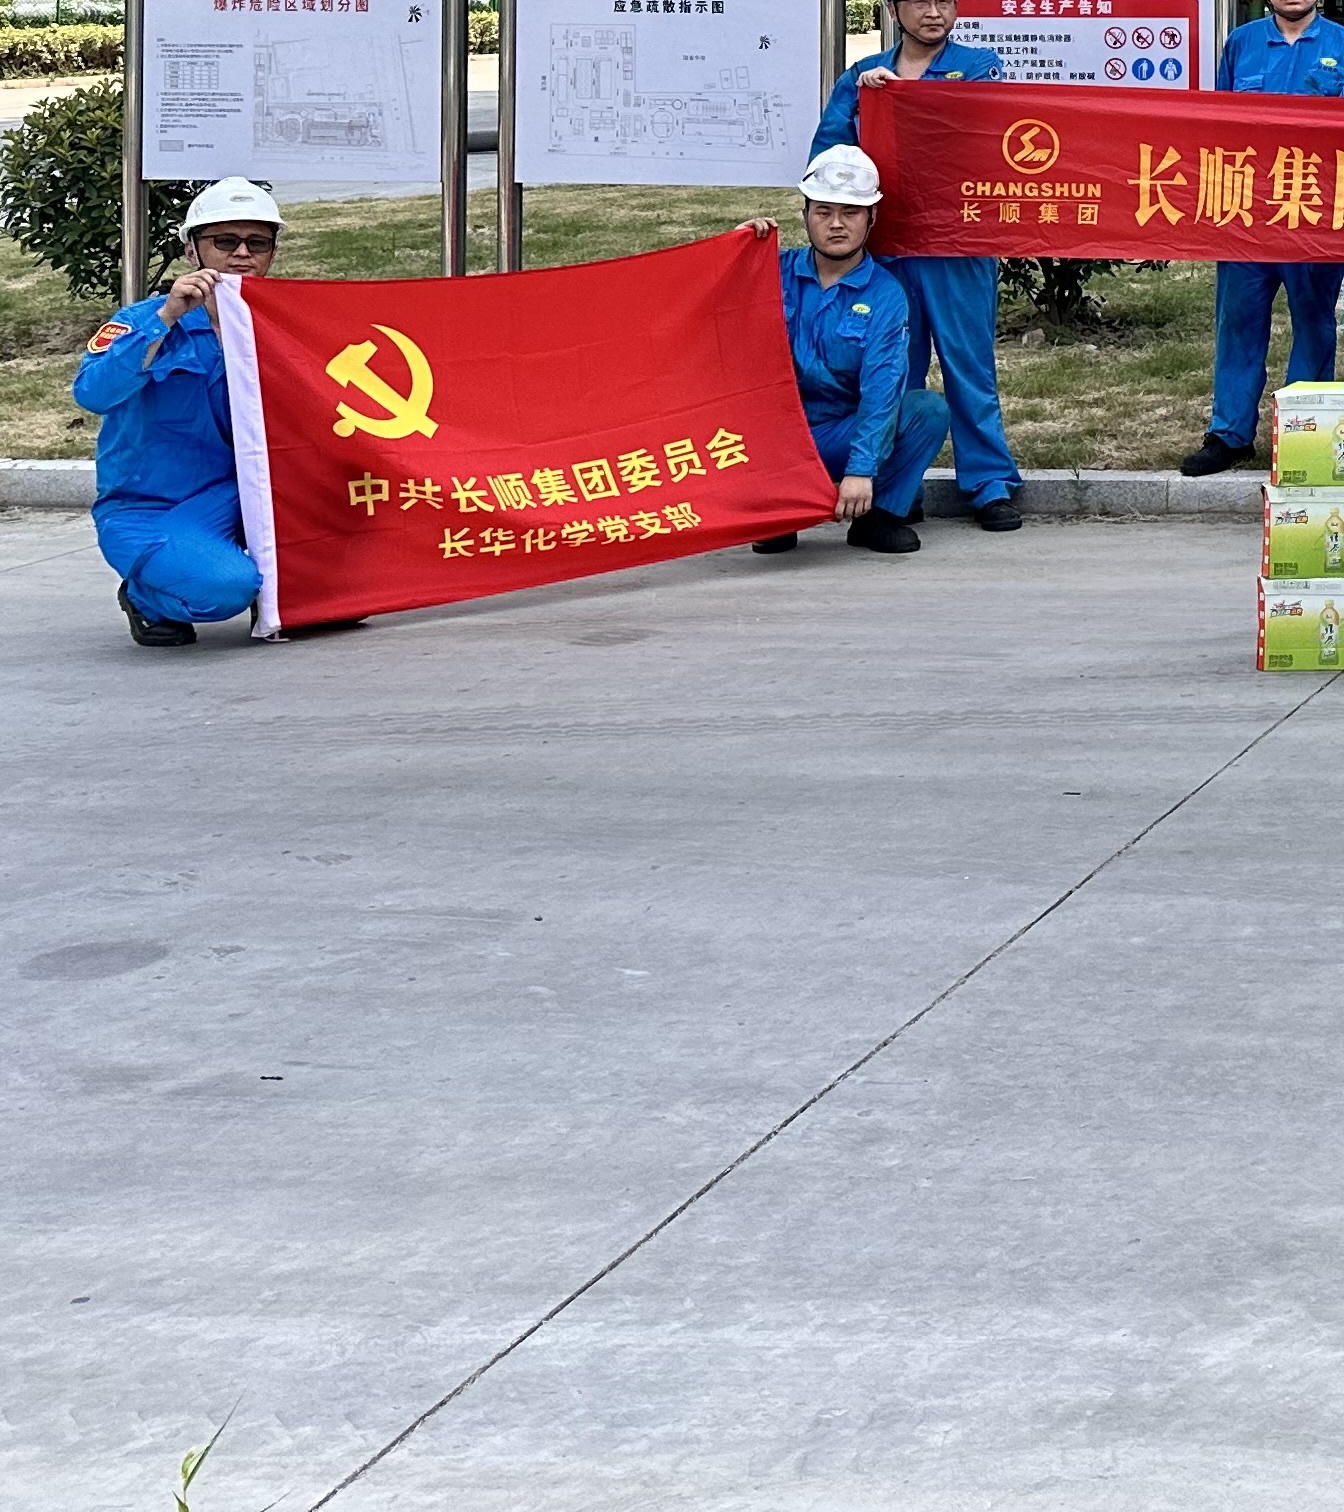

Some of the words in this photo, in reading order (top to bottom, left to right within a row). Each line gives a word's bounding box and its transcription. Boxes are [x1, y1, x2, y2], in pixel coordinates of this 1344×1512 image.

[613, 0, 725, 14] 应急疏散指示图
[1001, 0, 1113, 15] 安全生产告知
[960, 181, 1102, 197] CHANGSHUN
[960, 202, 1099, 225] 长顺集团
[348, 428, 750, 517] 中共长顺集团委员会
[438, 501, 703, 561] 长华化学党支部
